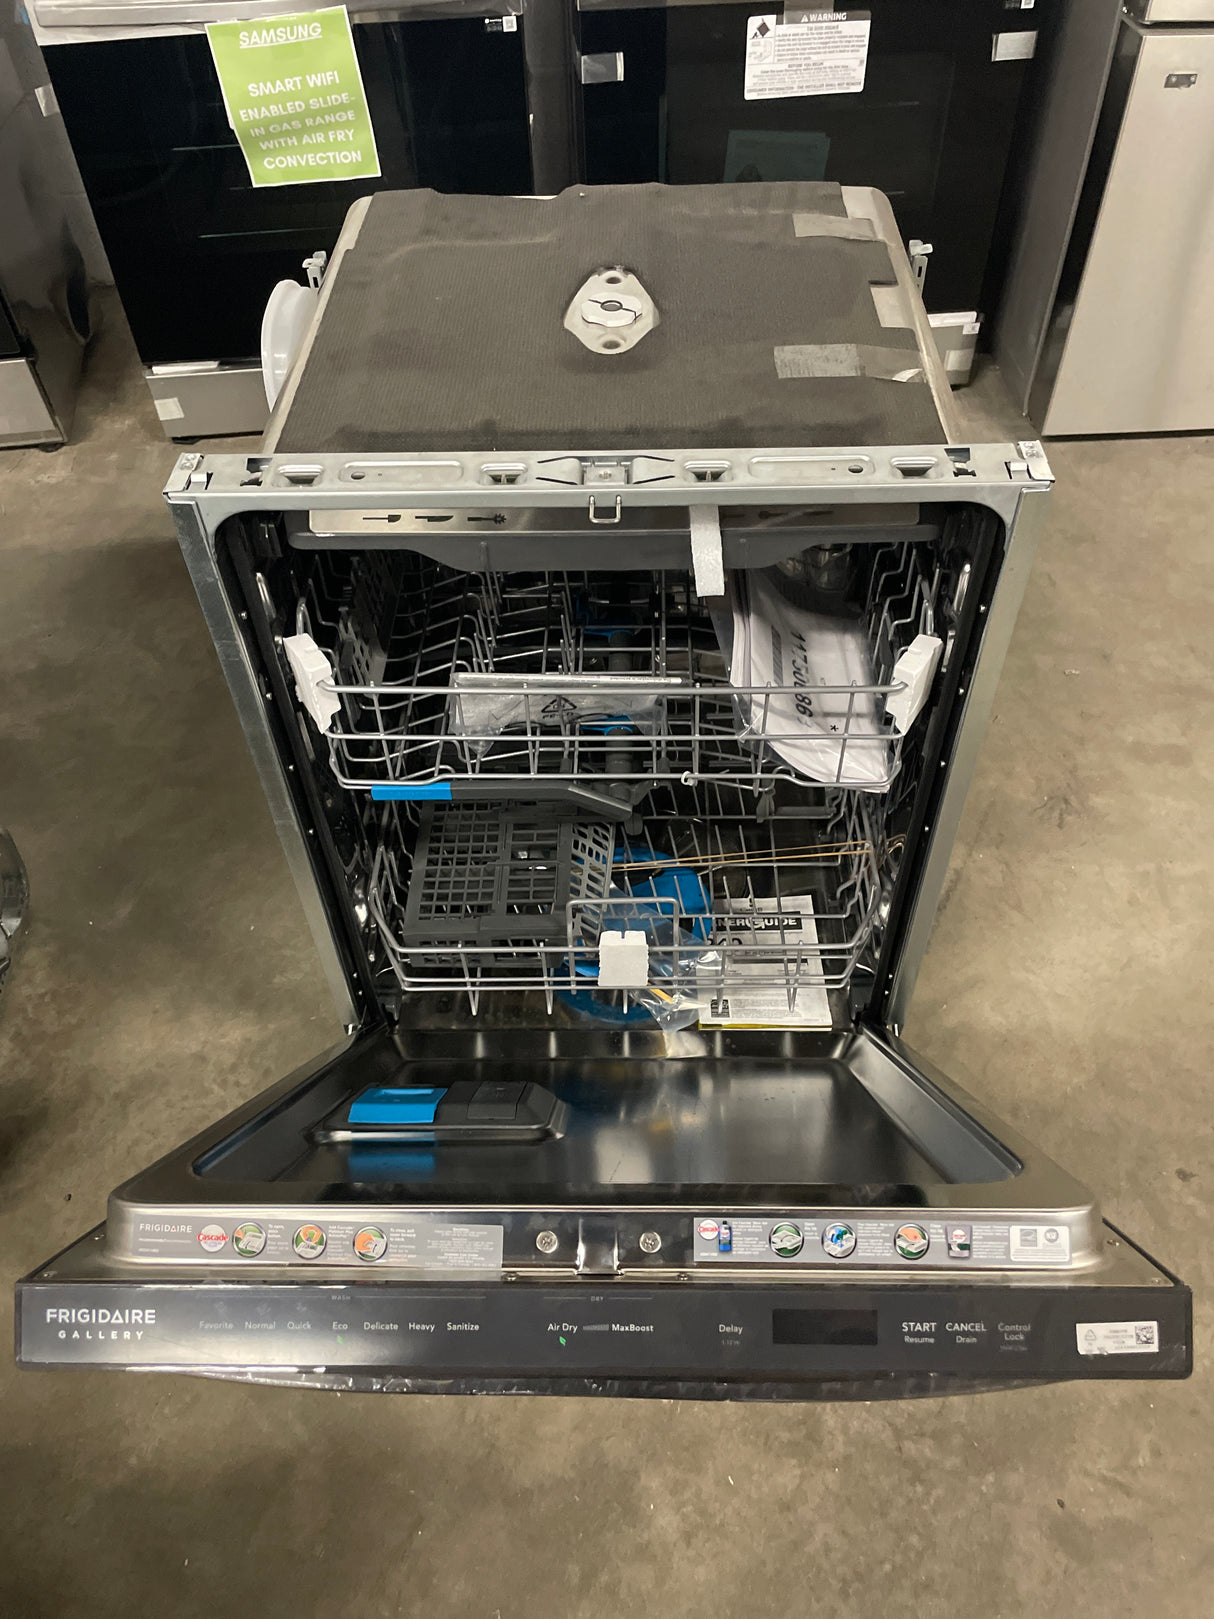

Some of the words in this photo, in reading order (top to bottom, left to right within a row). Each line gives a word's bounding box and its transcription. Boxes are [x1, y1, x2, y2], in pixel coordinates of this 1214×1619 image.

[810, 12, 847, 21] WARNING
[239, 22, 322, 48] SAMSUNG
[248, 76, 302, 97] SMART
[306, 71, 340, 88] WIFI
[239, 100, 305, 122] ENABLED
[250, 127, 265, 137] IN
[269, 121, 302, 134] GAS
[305, 110, 356, 127] RANGE
[259, 135, 298, 151] WITH
[302, 131, 325, 145] AIR
[329, 129, 355, 142] FRY
[263, 151, 362, 169] CONVECTION
[139, 1223, 192, 1233] FRIGIDAIRE
[197, 1233, 229, 1242] Cascade
[46, 1309, 156, 1324] FRIGIDAIRE
[199, 1321, 234, 1330] Favorite
[245, 1321, 276, 1330] Normal
[287, 1321, 312, 1330] Quick
[332, 1322, 348, 1331] Eco
[363, 1321, 399, 1331] Delicate
[408, 1322, 436, 1333] Heavy
[446, 1322, 480, 1331] Sanitize
[547, 1323, 560, 1332] Air
[562, 1323, 578, 1334] Dry
[611, 1323, 654, 1332] MaxBoost
[718, 1324, 743, 1335] Delay
[902, 1322, 937, 1332] START
[945, 1322, 987, 1333] CANCEL
[998, 1322, 1031, 1331] Control
[58, 1330, 144, 1340] GALLERY
[904, 1335, 935, 1344] Resume
[956, 1335, 977, 1344] Drain
[1004, 1332, 1025, 1341] Lock
